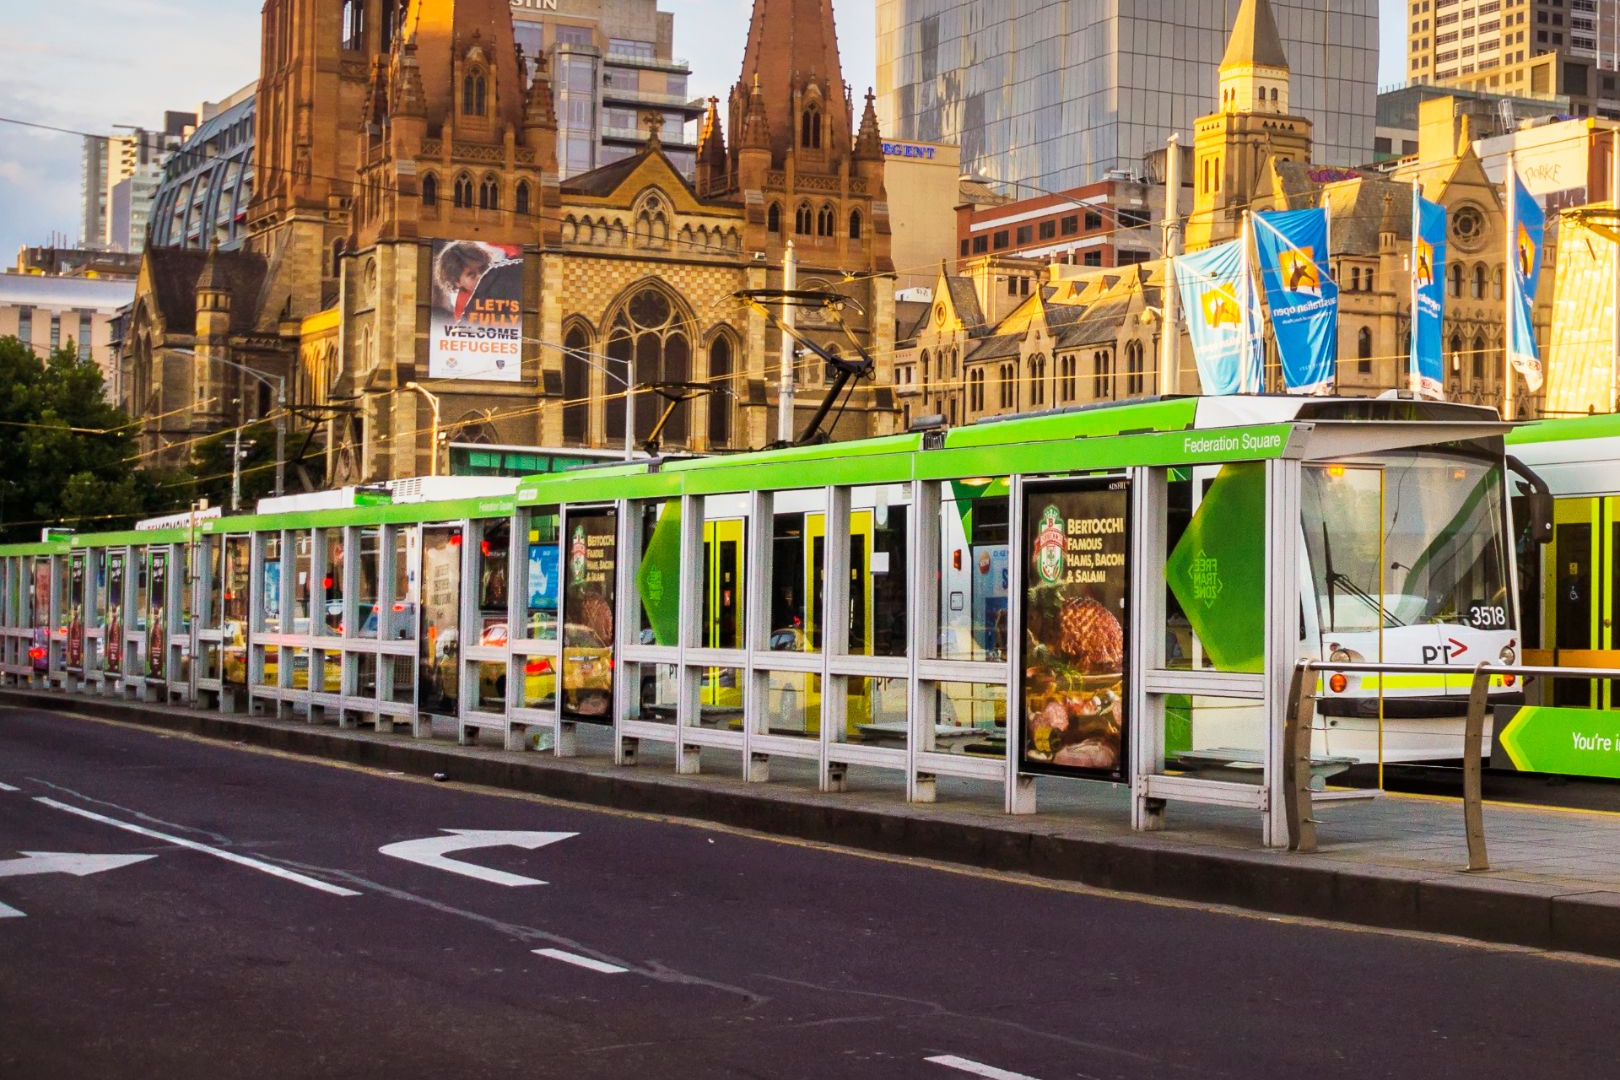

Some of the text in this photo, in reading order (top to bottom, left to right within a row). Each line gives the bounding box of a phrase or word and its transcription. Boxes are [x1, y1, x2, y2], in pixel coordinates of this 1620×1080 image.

[882, 143, 936, 160] EGENT
[475, 298, 520, 312] LET'S
[444, 325, 519, 340] WELCOME
[439, 339, 518, 354] REFUGEES
[1184, 432, 1281, 454] Federation Square
[1067, 517, 1124, 535] BERTOCCHI
[1067, 538, 1102, 551] FAMOUS
[1067, 552, 1125, 568] HAMS, BACON
[1067, 569, 1106, 584] & SALAMI
[1470, 606, 1506, 626] 3518
[1572, 731, 1613, 752] You're
